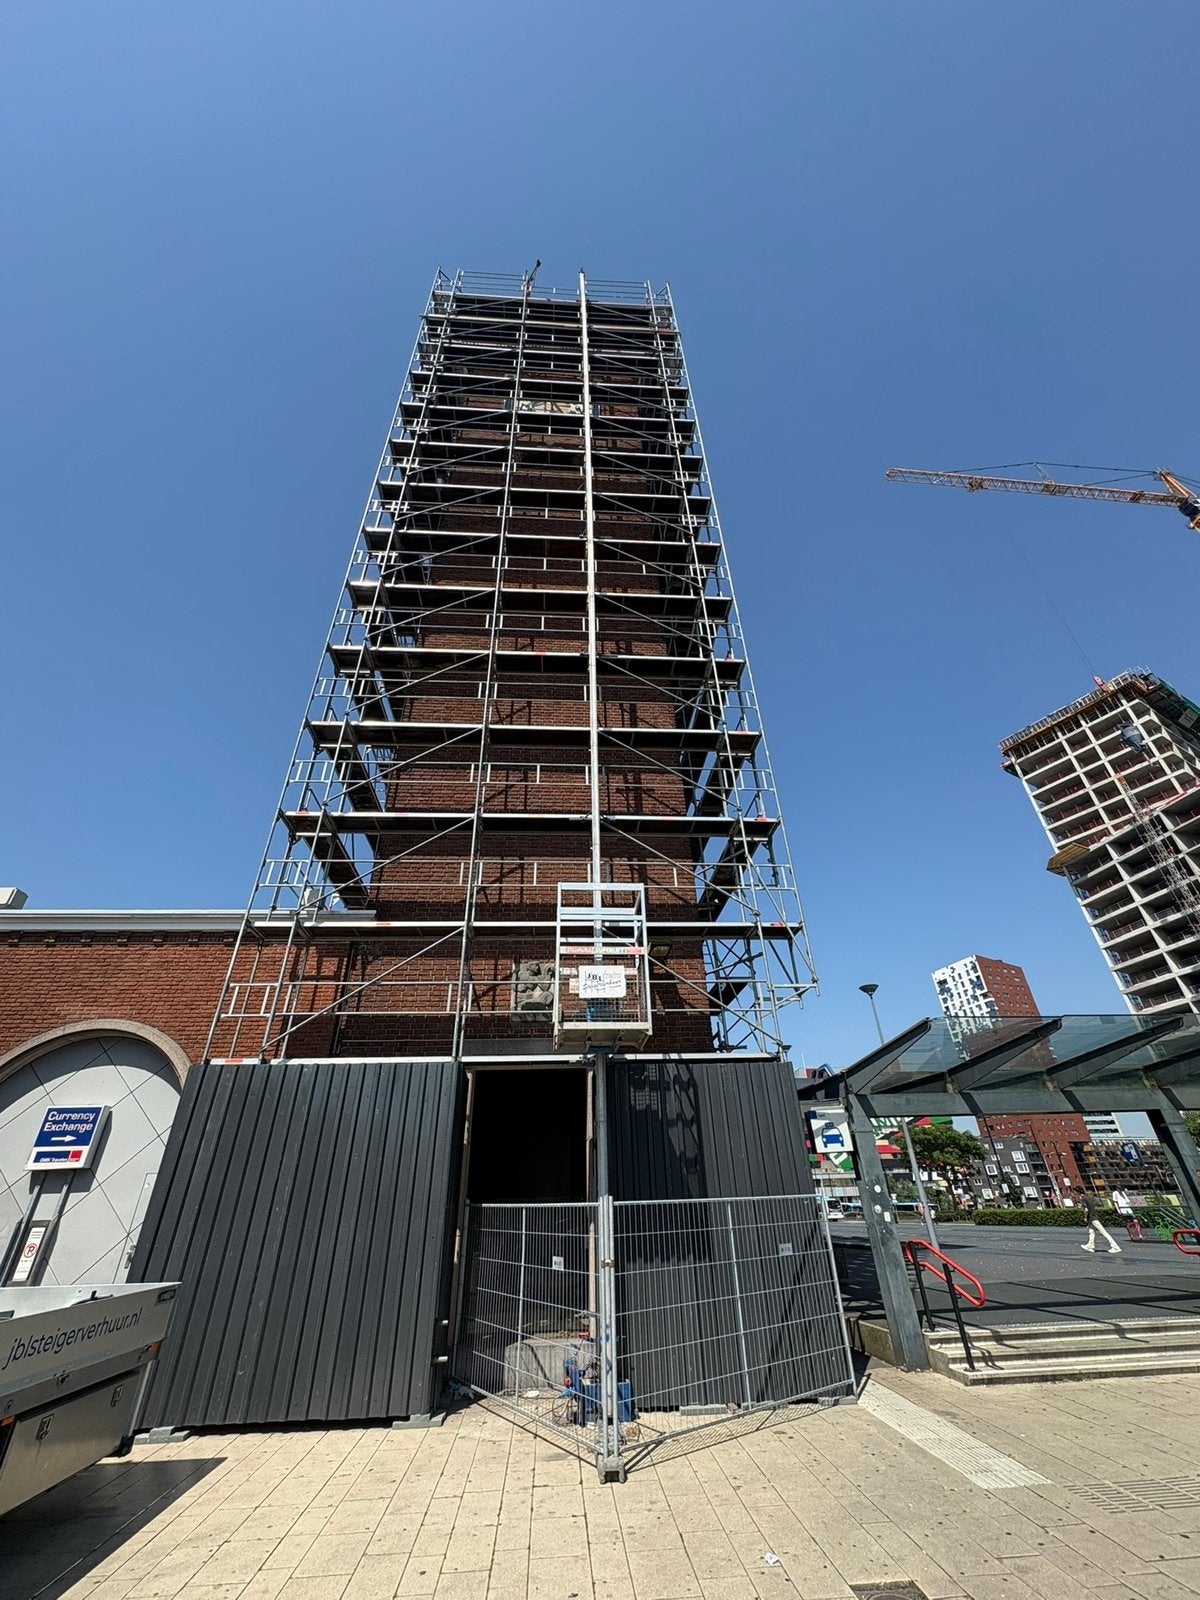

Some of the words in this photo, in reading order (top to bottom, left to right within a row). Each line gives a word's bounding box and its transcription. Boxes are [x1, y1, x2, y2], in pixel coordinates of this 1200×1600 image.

[48, 1111, 96, 1122] Currency
[43, 1122, 93, 1133] Exchange
[1, 1307, 143, 1371] jblsteigerverhuur.nl
